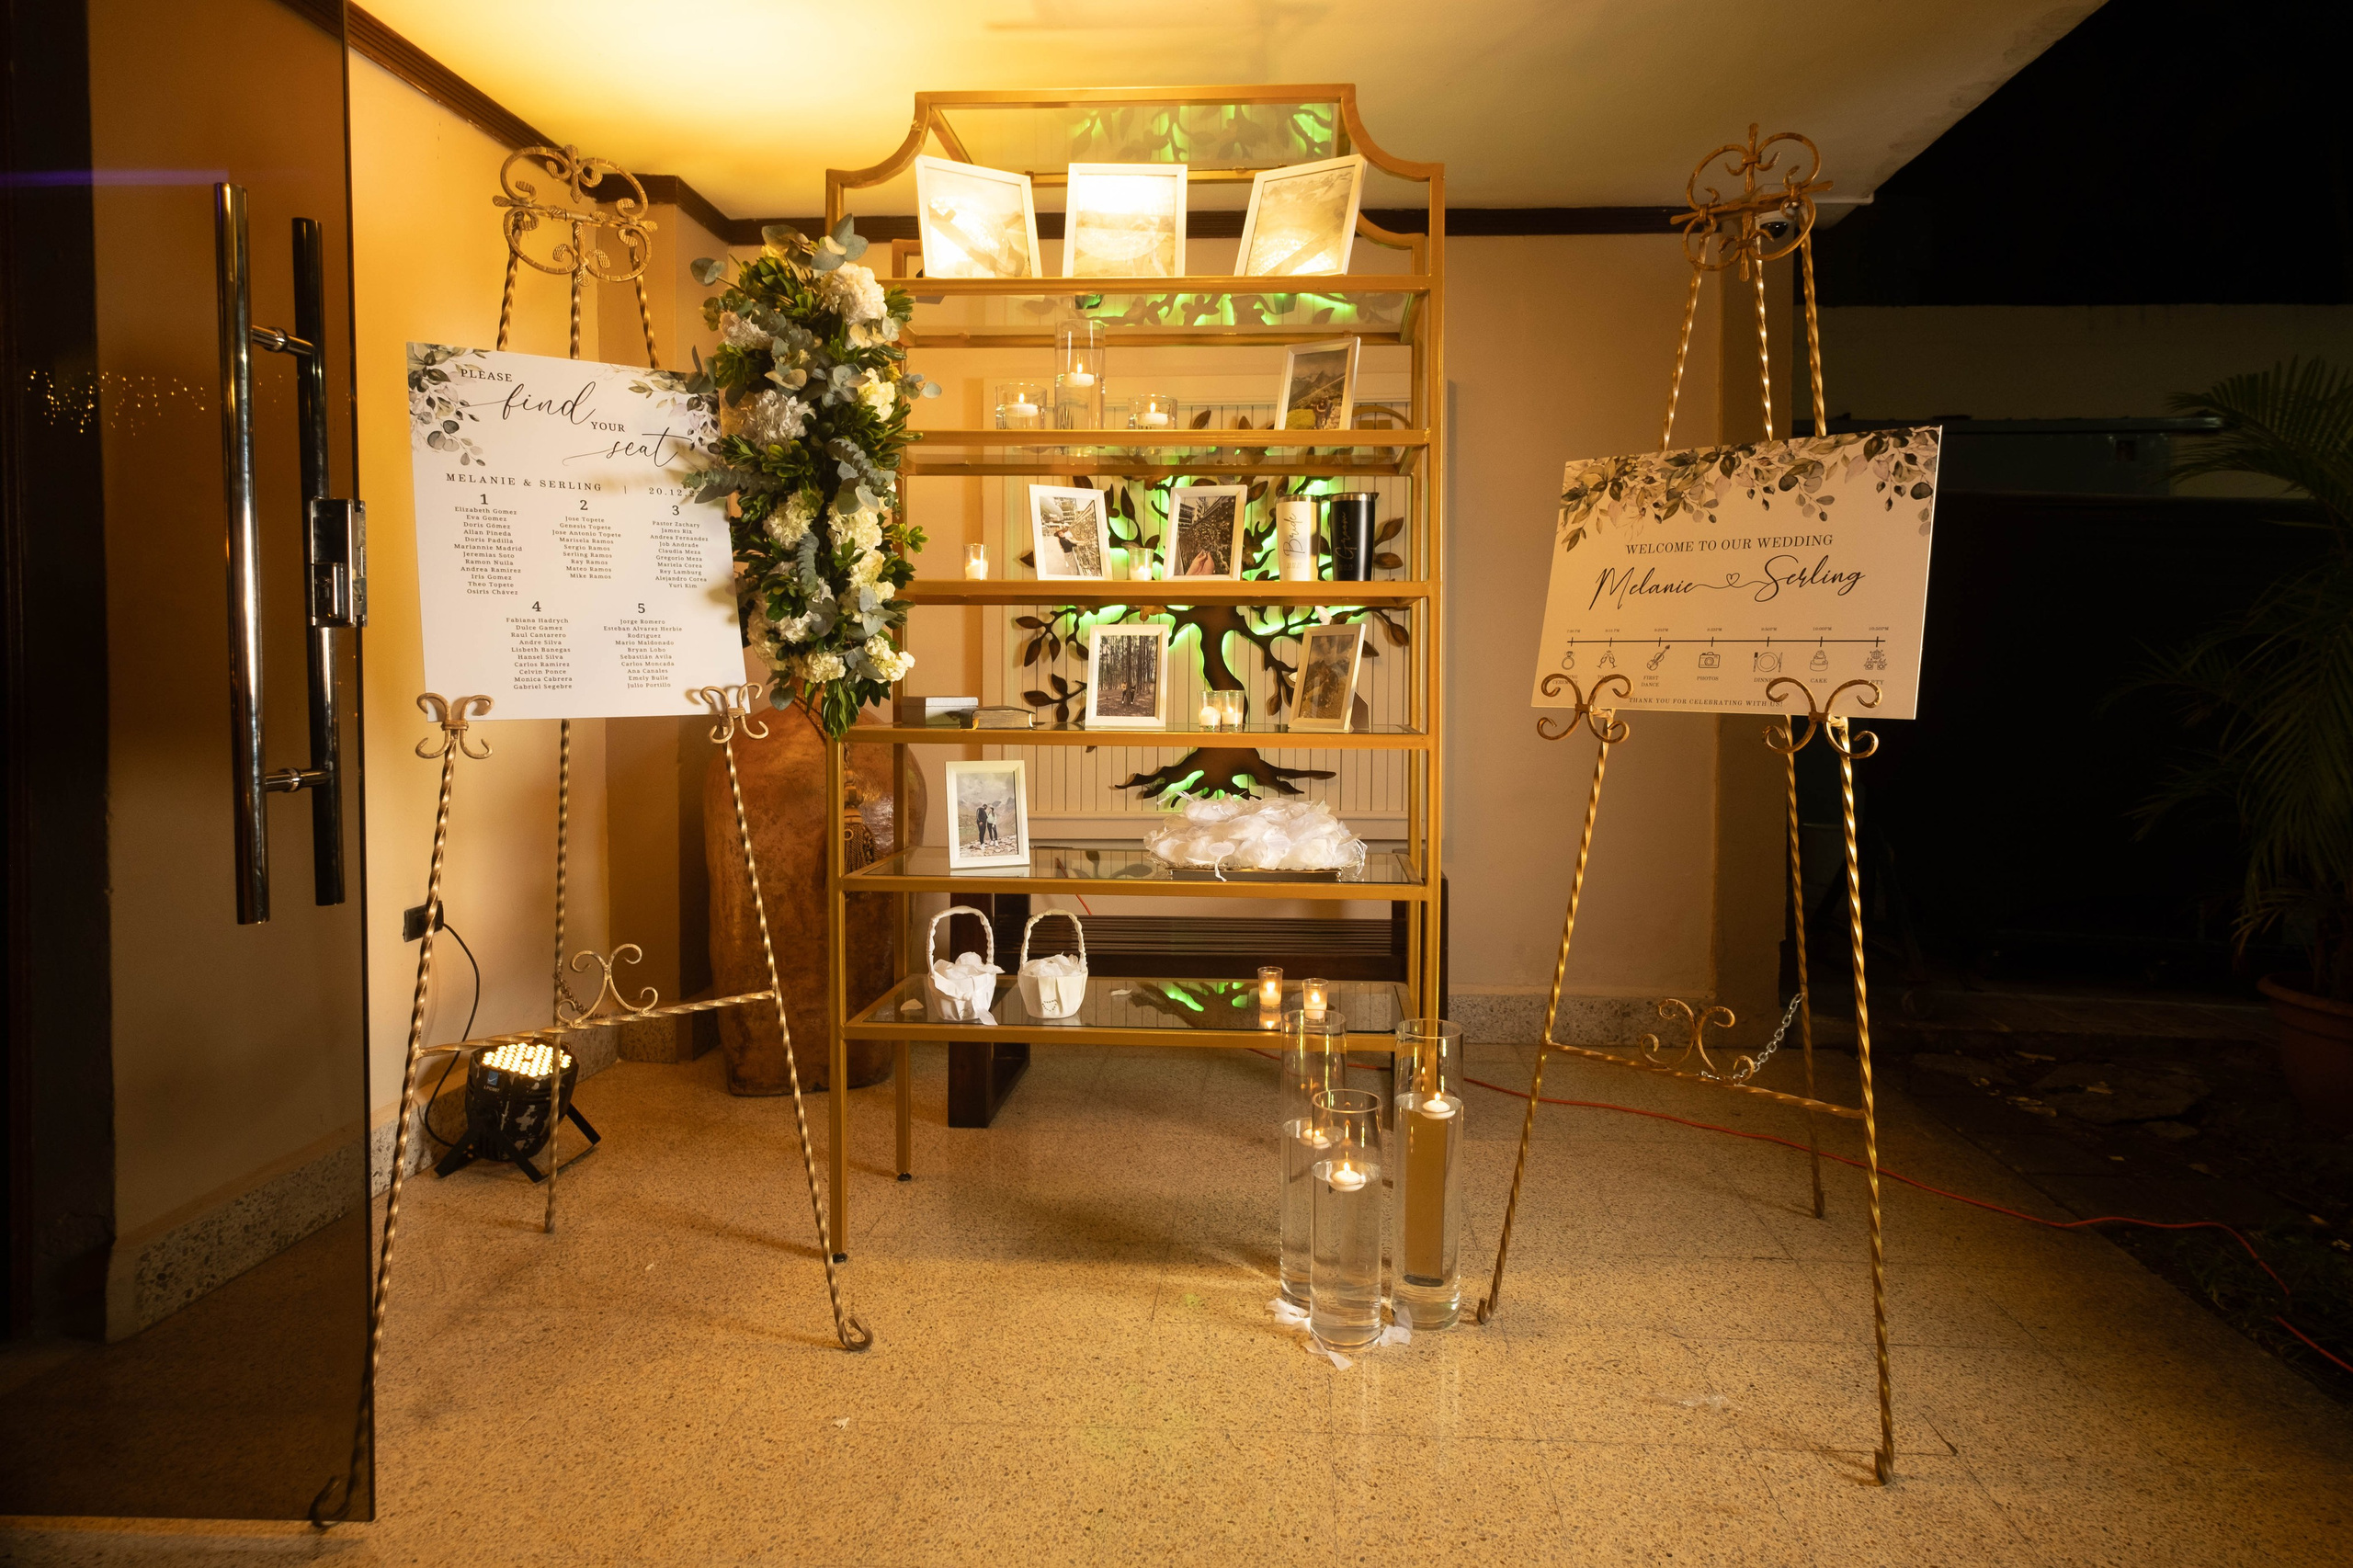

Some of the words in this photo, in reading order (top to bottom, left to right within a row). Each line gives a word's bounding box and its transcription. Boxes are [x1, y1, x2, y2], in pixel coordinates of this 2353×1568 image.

[460, 369, 513, 382] PLEASE
[462, 381, 597, 426] find
[590, 420, 626, 433] YOUR
[562, 426, 693, 468] seat
[446, 472, 517, 486] MELANIE
[523, 478, 532, 487] &
[540, 479, 602, 492] SERLING
[480, 494, 489, 505] 1
[579, 499, 588, 511] 2
[672, 505, 680, 516] 3
[1282, 512, 1305, 557] Bride
[1625, 541, 1694, 555] WELCOME
[1699, 540, 1717, 551] TO
[1721, 539, 1752, 551] OUR
[1756, 534, 1834, 549] WEDDING
[1588, 566, 1700, 611] Melanie
[1754, 554, 1866, 603] Serling
[531, 600, 542, 612] 4
[637, 603, 646, 614] 5
